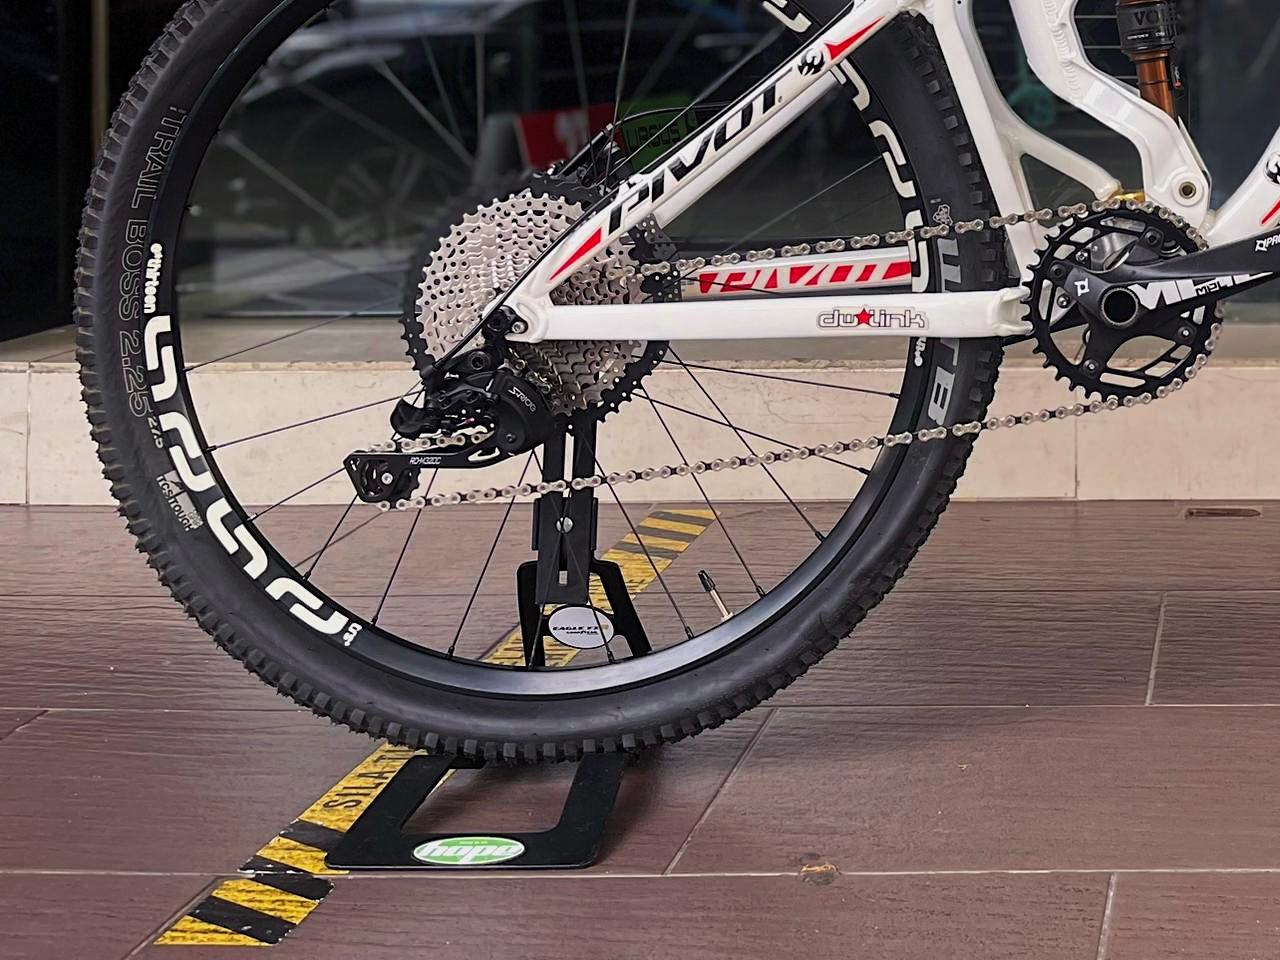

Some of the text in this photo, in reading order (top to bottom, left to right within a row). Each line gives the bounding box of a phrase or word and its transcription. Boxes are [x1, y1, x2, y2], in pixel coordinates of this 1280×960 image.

[131, 114, 188, 208] TRAIL
[608, 66, 792, 235] PIVOT
[119, 219, 150, 321] BOSS
[120, 329, 155, 418] 2.25
[419, 840, 519, 865] hope
